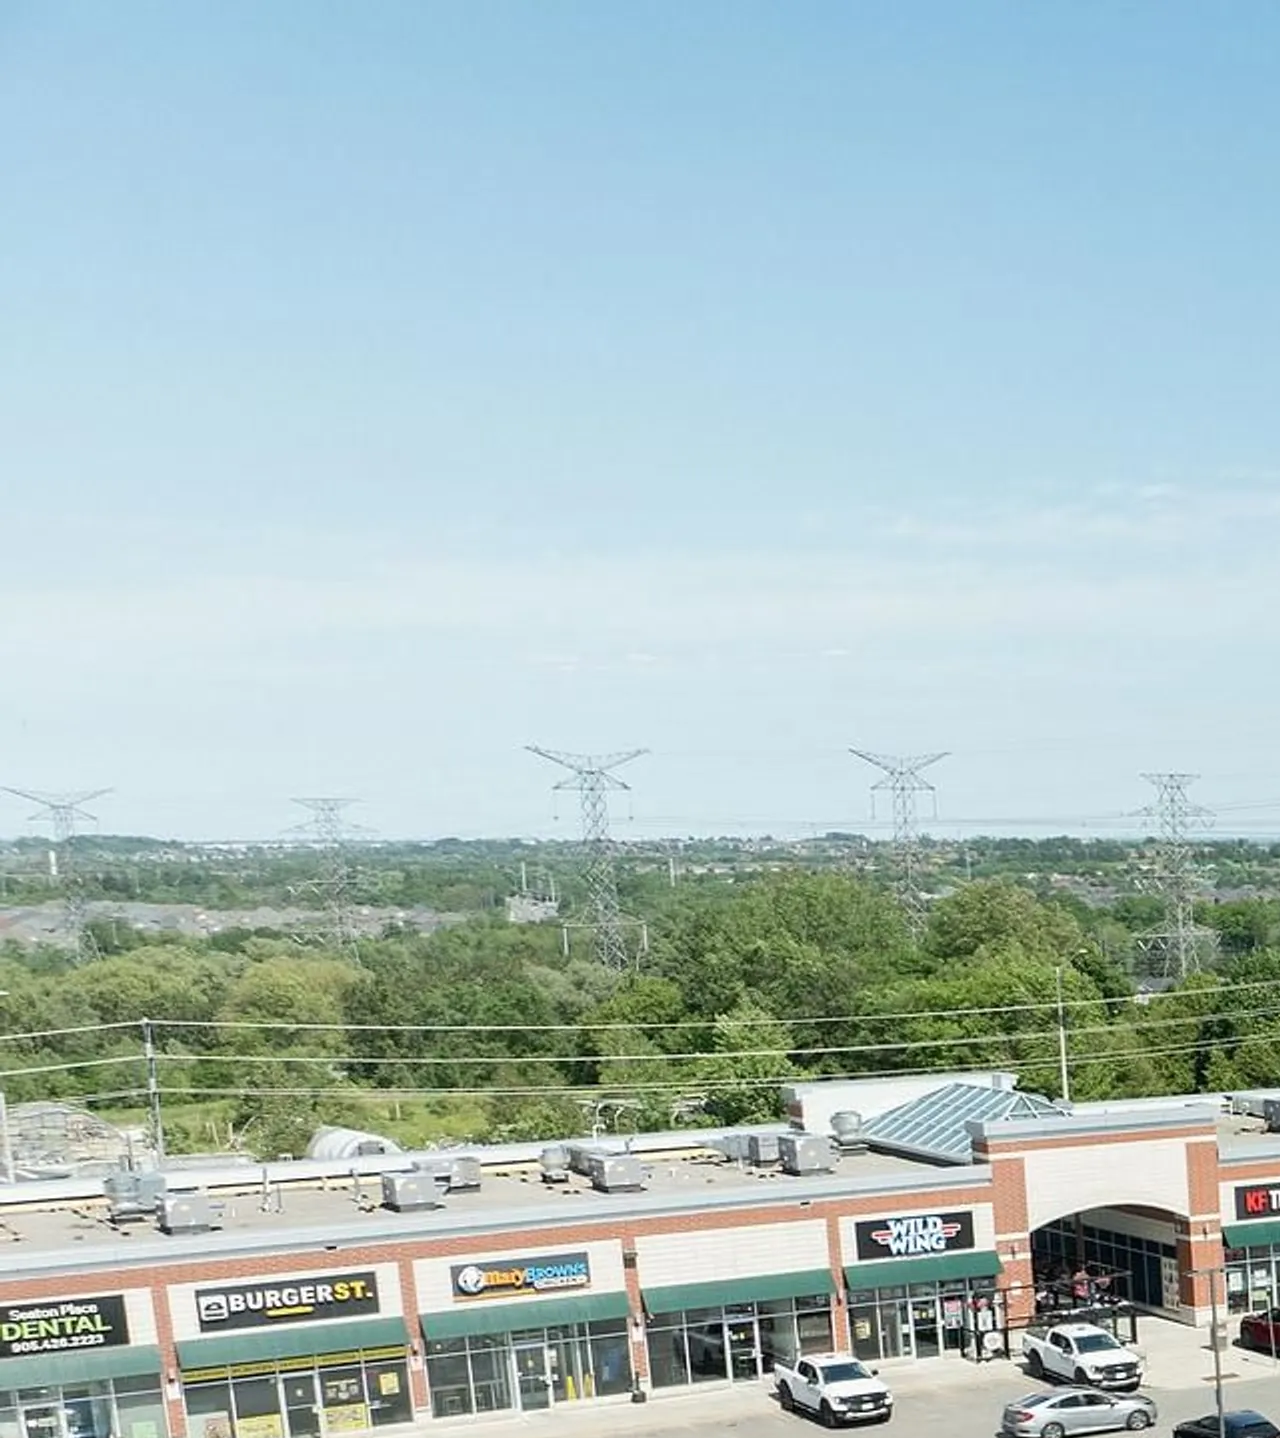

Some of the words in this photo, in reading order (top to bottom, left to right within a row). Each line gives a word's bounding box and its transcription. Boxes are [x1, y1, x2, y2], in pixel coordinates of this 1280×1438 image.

[1245, 1190, 1267, 1212] KF
[887, 1216, 944, 1237] WILD
[888, 1233, 947, 1255] WING
[8, 1308, 59, 1322] Seaton
[59, 1303, 98, 1316] Place
[1, 1314, 113, 1341] DENTAL
